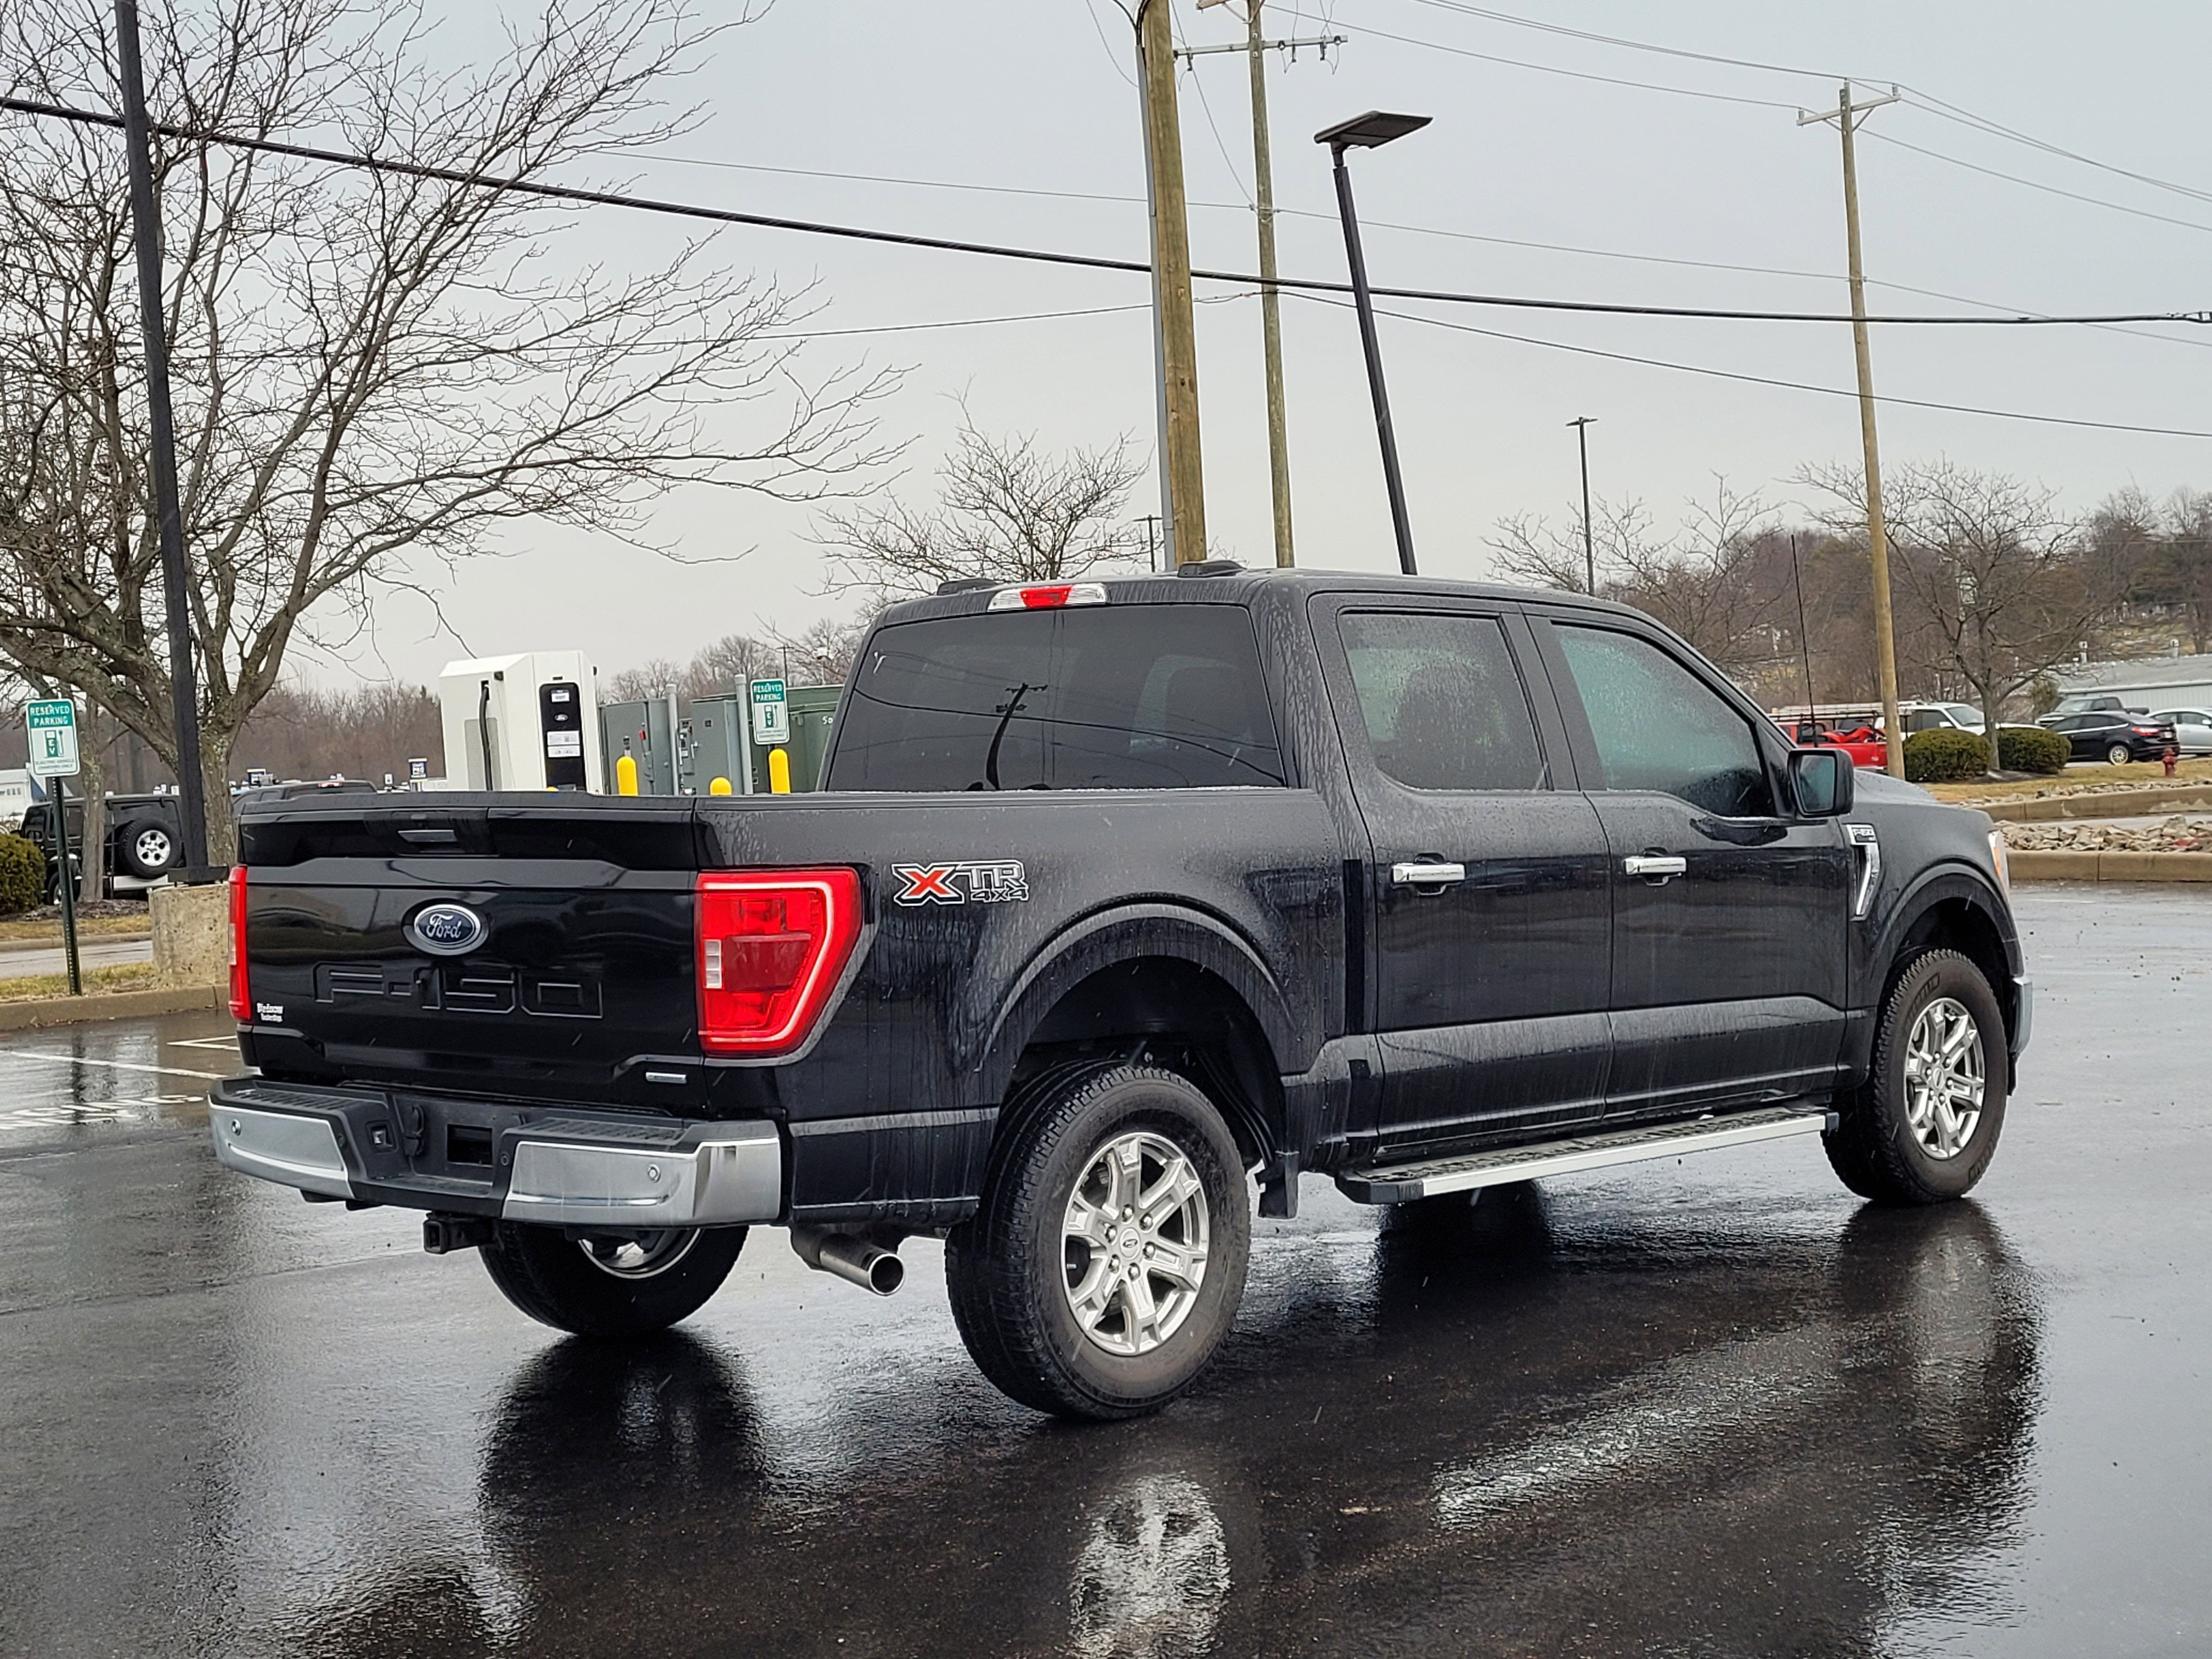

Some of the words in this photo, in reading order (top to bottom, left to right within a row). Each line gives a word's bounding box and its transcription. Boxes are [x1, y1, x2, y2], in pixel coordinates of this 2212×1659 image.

[30, 706, 70, 716] RESERVED
[33, 716, 69, 726] PARKING
[891, 859, 1029, 906] XTR
[426, 913, 462, 939] Ford
[312, 962, 603, 1019] F-150
